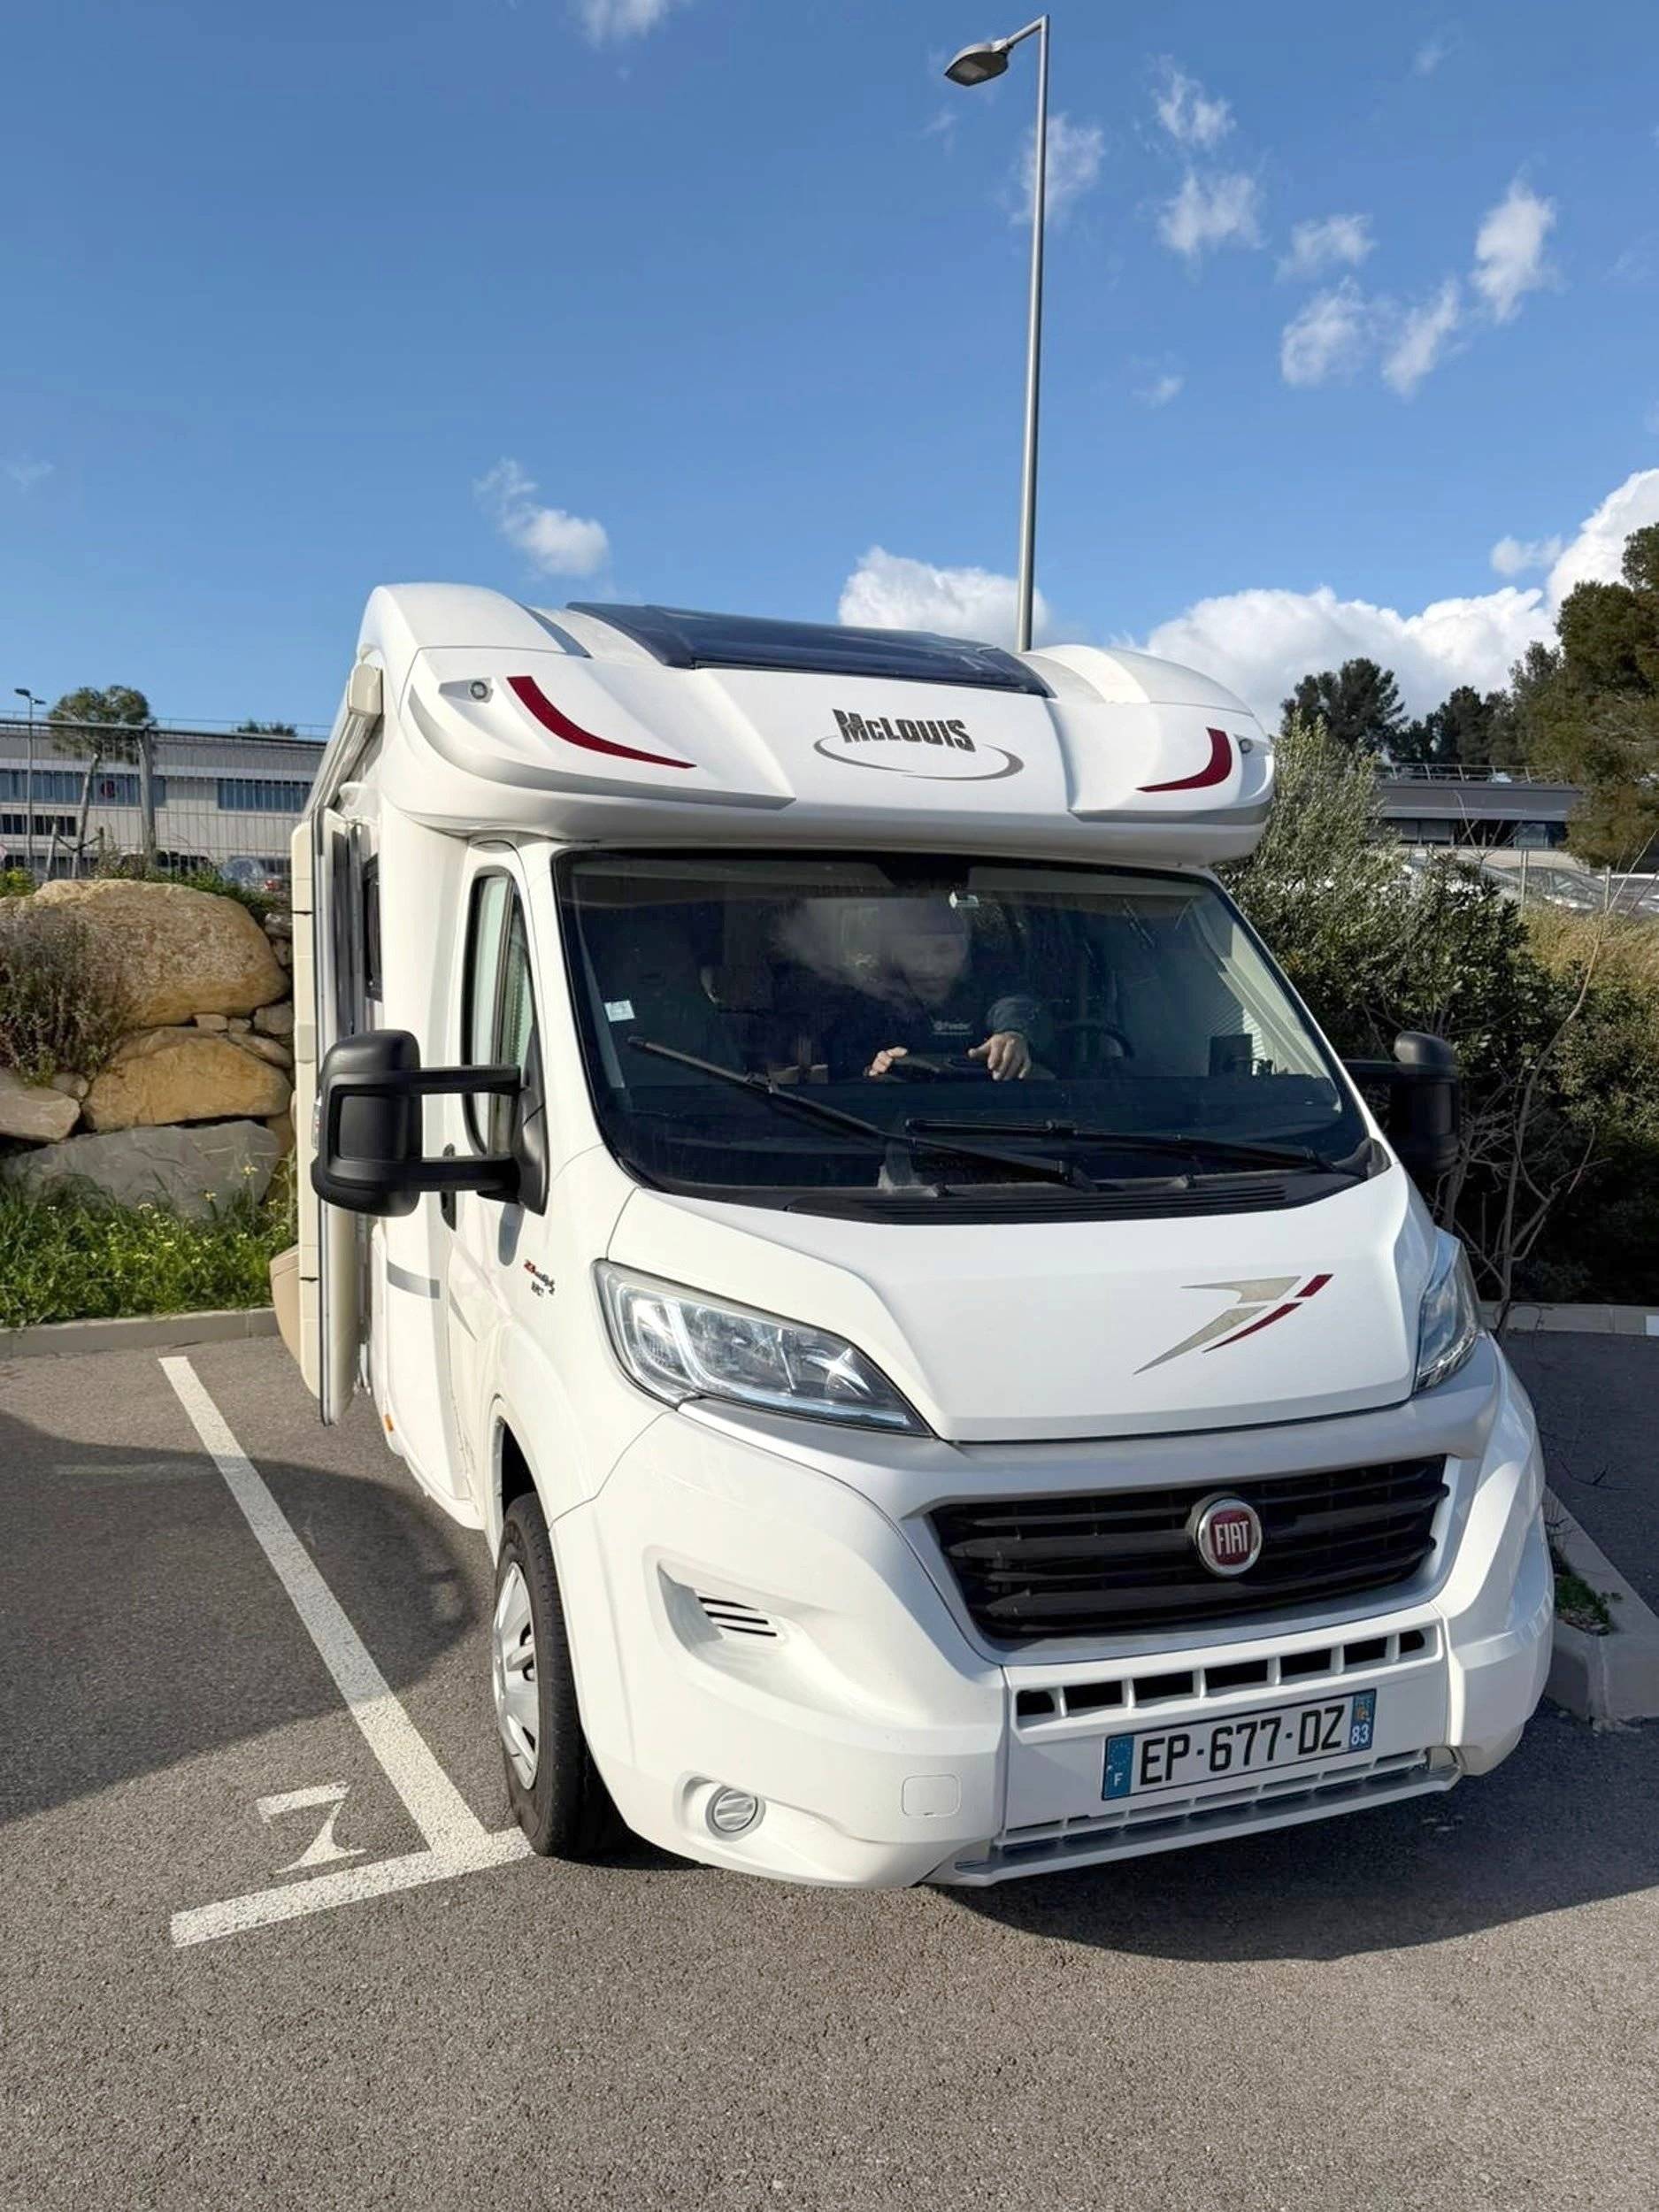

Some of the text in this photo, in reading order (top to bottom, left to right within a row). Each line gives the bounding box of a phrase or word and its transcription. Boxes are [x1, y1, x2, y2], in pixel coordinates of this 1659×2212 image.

[1215, 1521, 1248, 1555] FIAT
[1140, 1704, 1345, 1786] EP-677-DZ
[1351, 1724, 1369, 1746] 83
[1112, 1772, 1124, 1786] F
